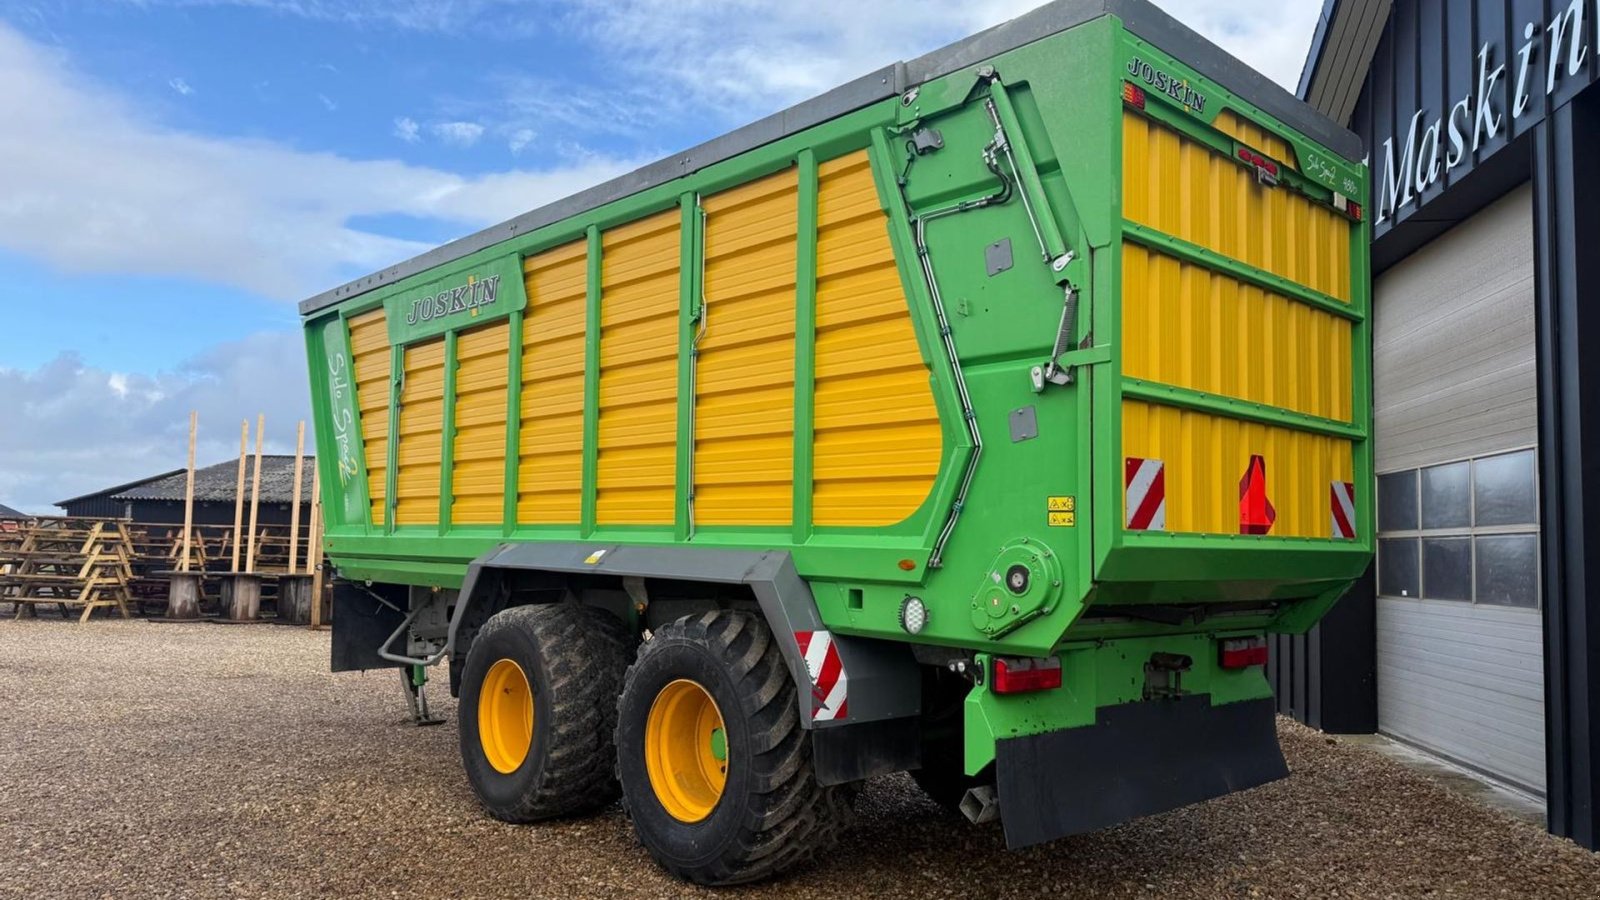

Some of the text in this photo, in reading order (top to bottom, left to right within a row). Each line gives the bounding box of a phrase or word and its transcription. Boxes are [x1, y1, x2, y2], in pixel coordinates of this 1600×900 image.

[1127, 55, 1207, 114] JOSKIN
[1375, 0, 1600, 226] Maskin
[407, 275, 499, 325] JOSKIN
[327, 352, 348, 399] Silo
